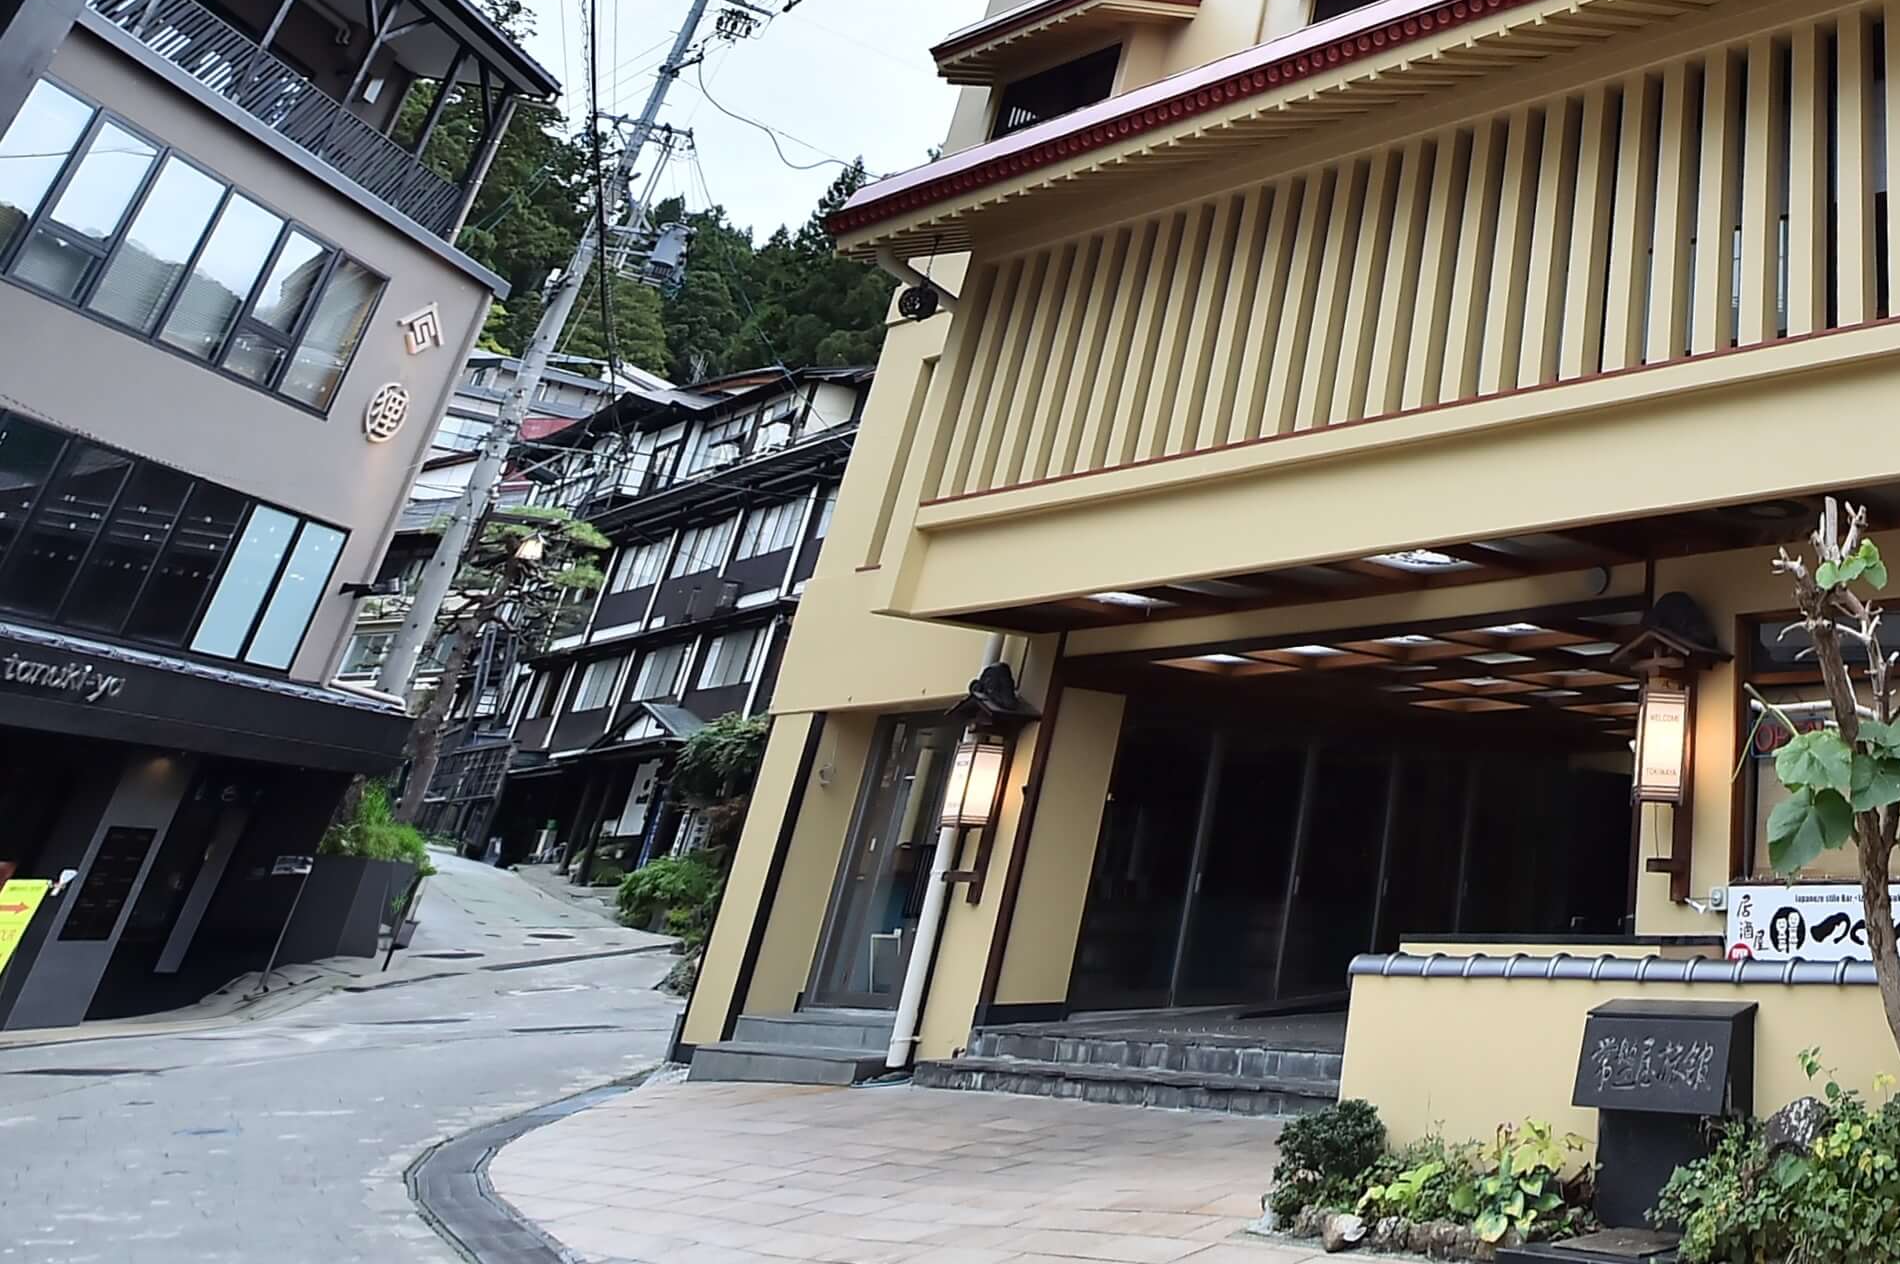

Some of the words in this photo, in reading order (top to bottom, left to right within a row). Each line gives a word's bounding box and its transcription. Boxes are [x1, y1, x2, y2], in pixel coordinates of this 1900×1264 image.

[3, 653, 126, 702] tanuki-ya
[1737, 894, 1769, 951] 居酒屋
